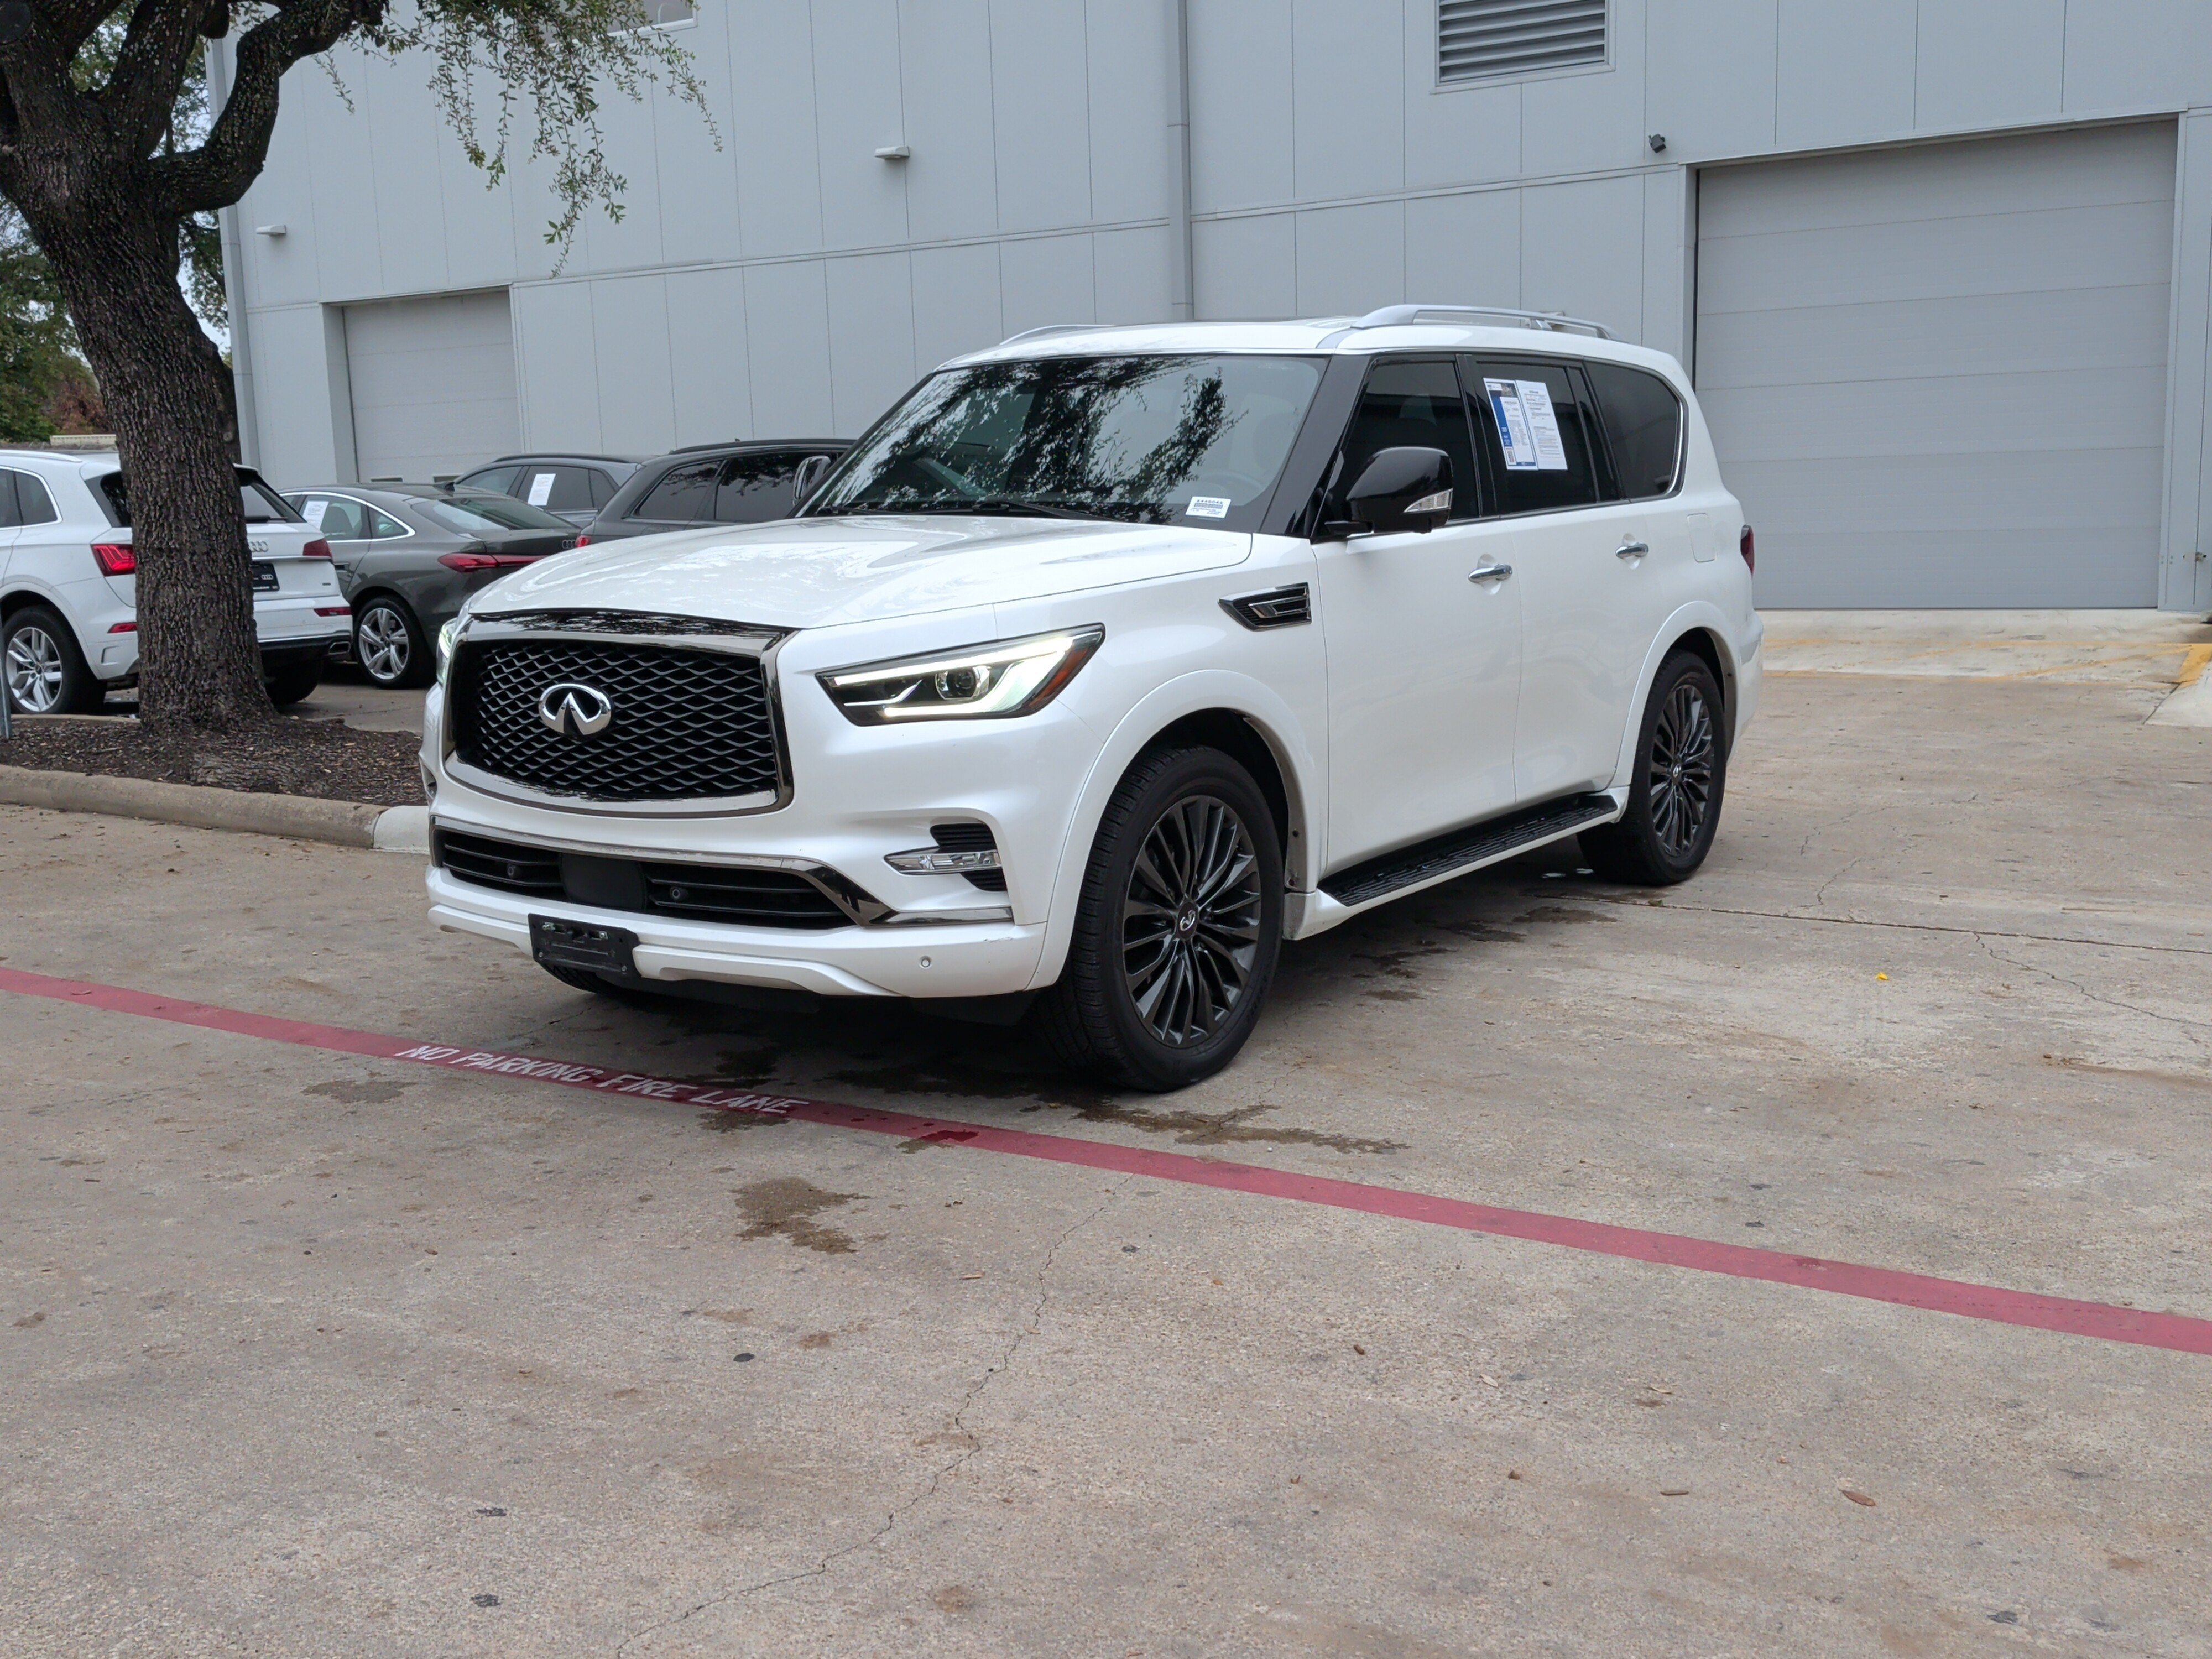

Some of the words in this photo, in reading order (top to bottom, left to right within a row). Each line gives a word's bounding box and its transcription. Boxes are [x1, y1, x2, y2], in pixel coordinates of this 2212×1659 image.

[394, 1045, 460, 1060] NO
[448, 1052, 604, 1082] PARKING
[595, 1074, 698, 1098] FIRE
[689, 1091, 810, 1113] LANE
